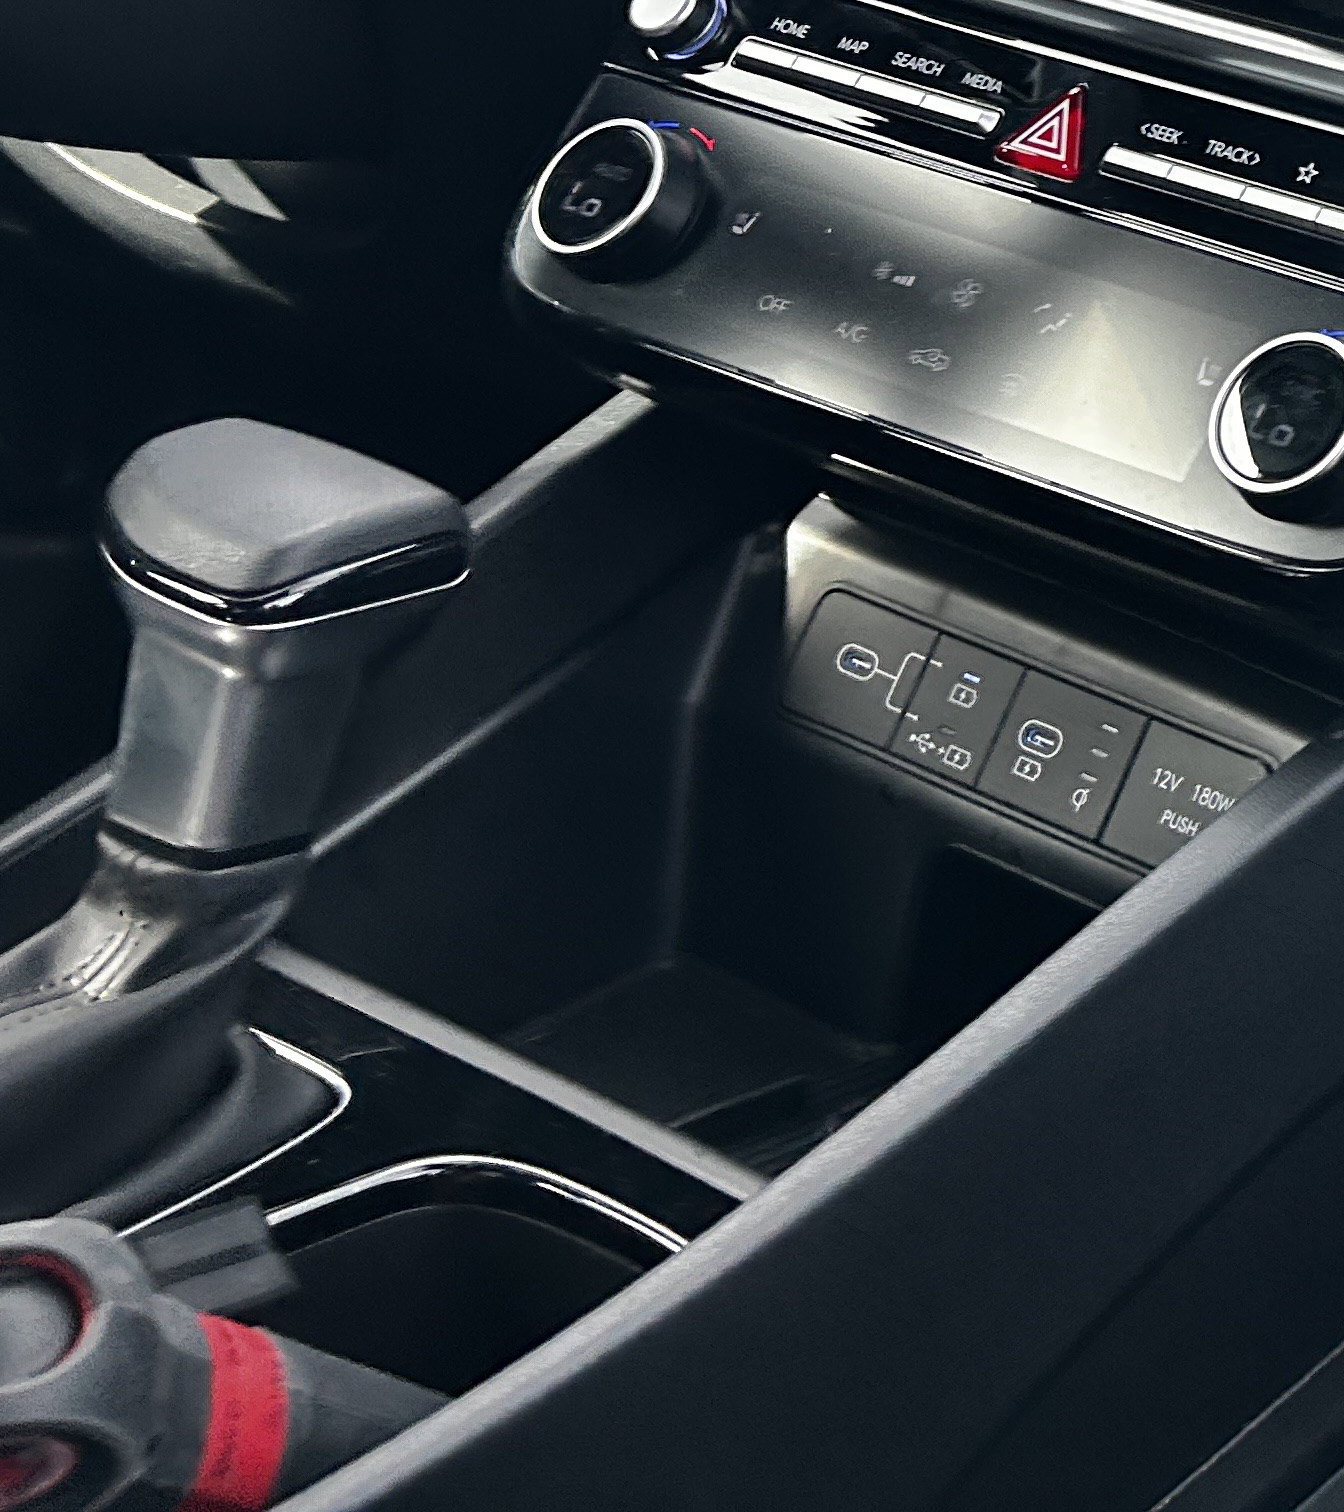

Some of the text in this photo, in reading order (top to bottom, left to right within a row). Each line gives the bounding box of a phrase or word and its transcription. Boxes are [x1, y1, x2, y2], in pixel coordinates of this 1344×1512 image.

[770, 17, 811, 39] HOME
[837, 37, 869, 54] MAP
[891, 51, 945, 77] SEARCH
[960, 71, 1004, 94] MEDIA
[1152, 768, 1237, 811] 12V 180W
[1160, 808, 1200, 836] PUSH
